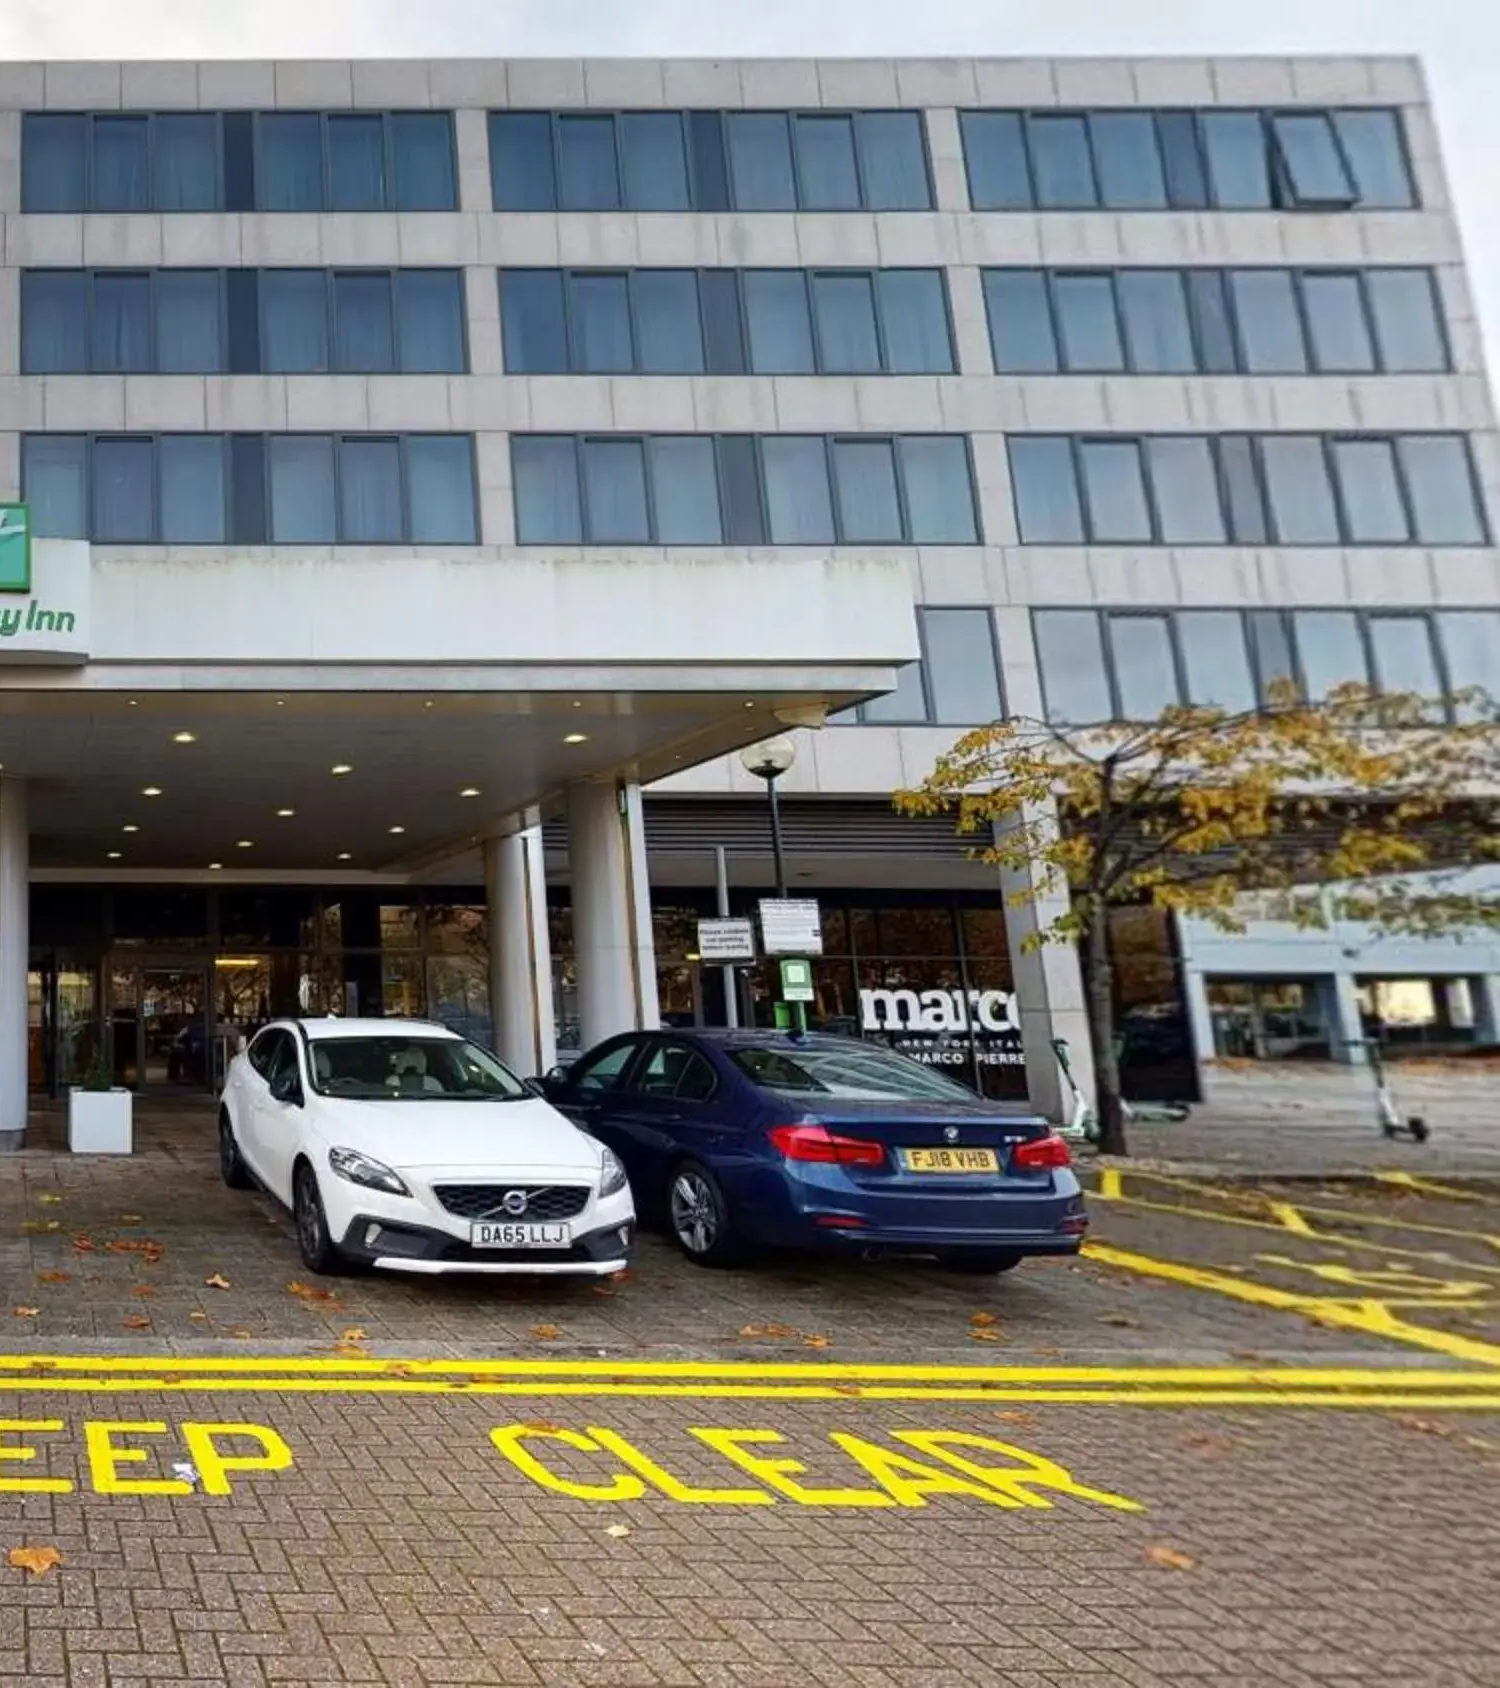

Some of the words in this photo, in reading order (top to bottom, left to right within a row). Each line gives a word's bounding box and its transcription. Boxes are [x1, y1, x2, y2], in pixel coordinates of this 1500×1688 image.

[27, 599, 76, 632] Inn
[975, 1053, 1026, 1065] PIERRE
[911, 1151, 952, 1168] FJ18
[954, 1151, 991, 1168] VHB
[480, 1225, 525, 1243] DA65
[530, 1226, 563, 1243] LLJ
[488, 1424, 1147, 1513] CLEAR
